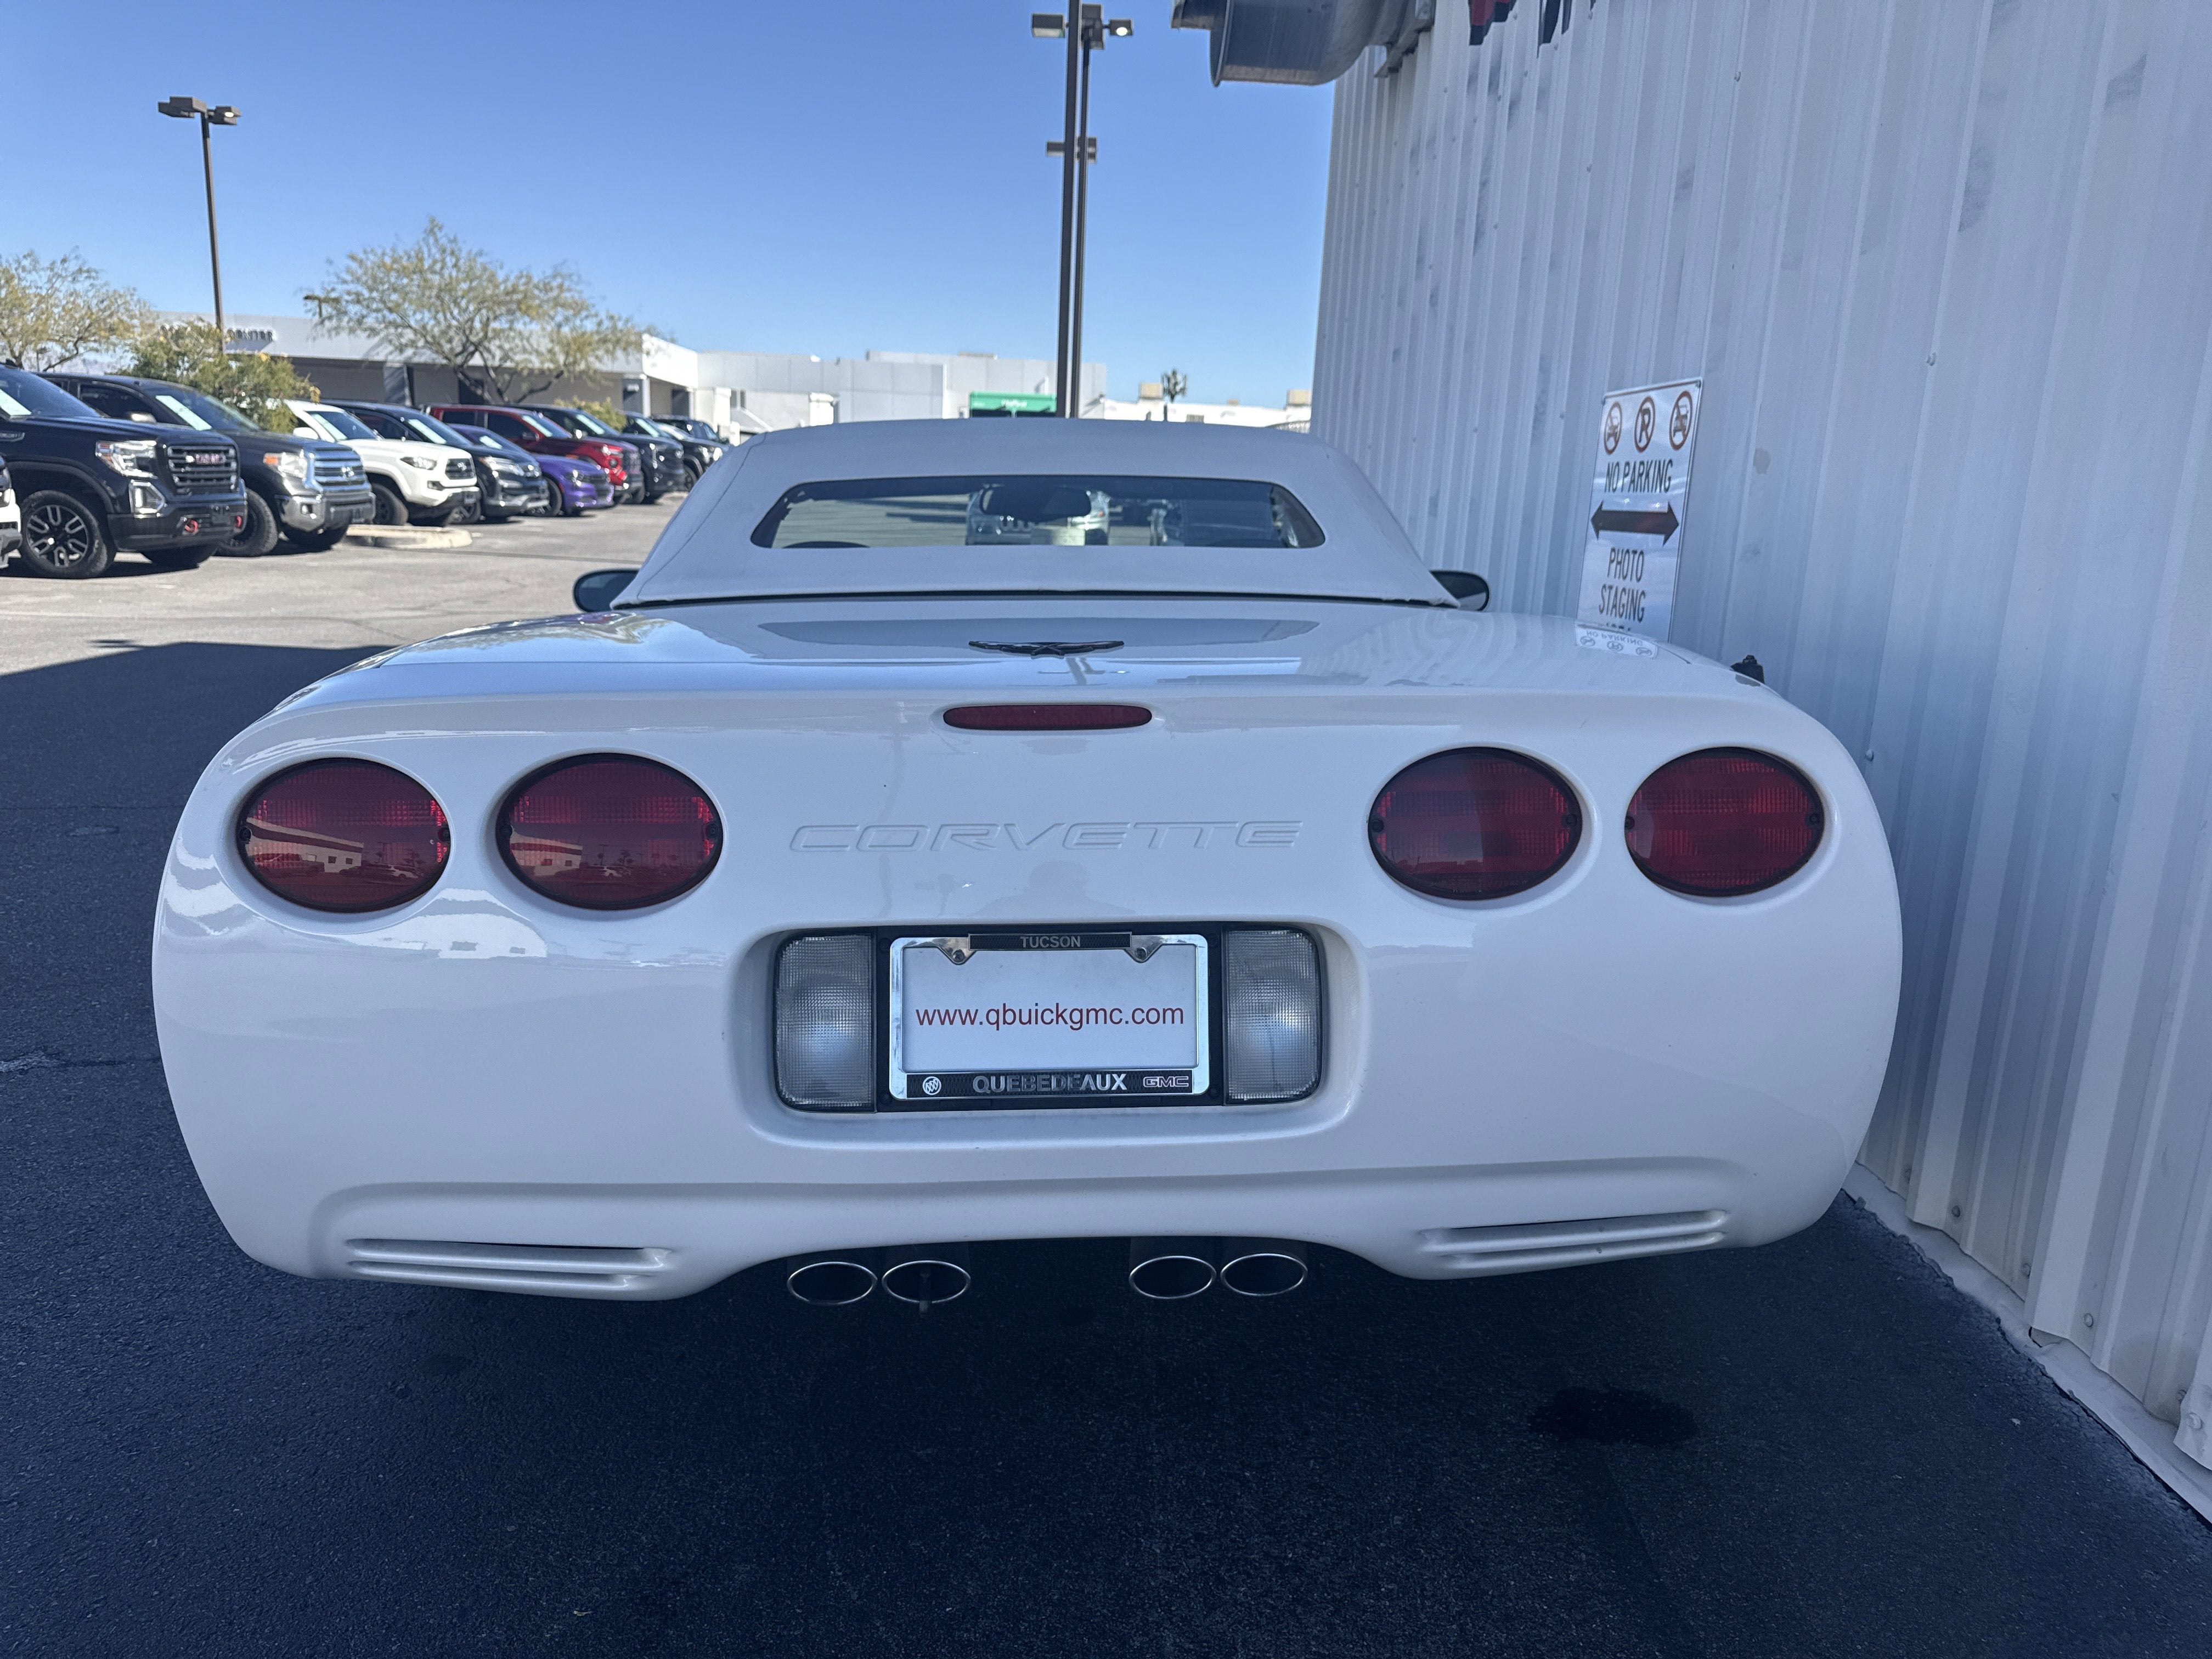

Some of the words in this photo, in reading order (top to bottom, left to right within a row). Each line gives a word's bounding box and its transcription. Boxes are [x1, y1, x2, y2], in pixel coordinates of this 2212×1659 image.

[1604, 461, 1620, 493] NO
[1621, 458, 1673, 493] PARKING
[1607, 547, 1644, 582] PHOTO
[1599, 584, 1646, 623] STAGING
[789, 820, 1304, 852] CORVETTE
[1020, 935, 1080, 948] TUCSON
[916, 1002, 1184, 1031] www.qbuickgmc.com
[972, 1073, 1127, 1093] QUEBEDEAUX
[1143, 1076, 1189, 1087] GMC
